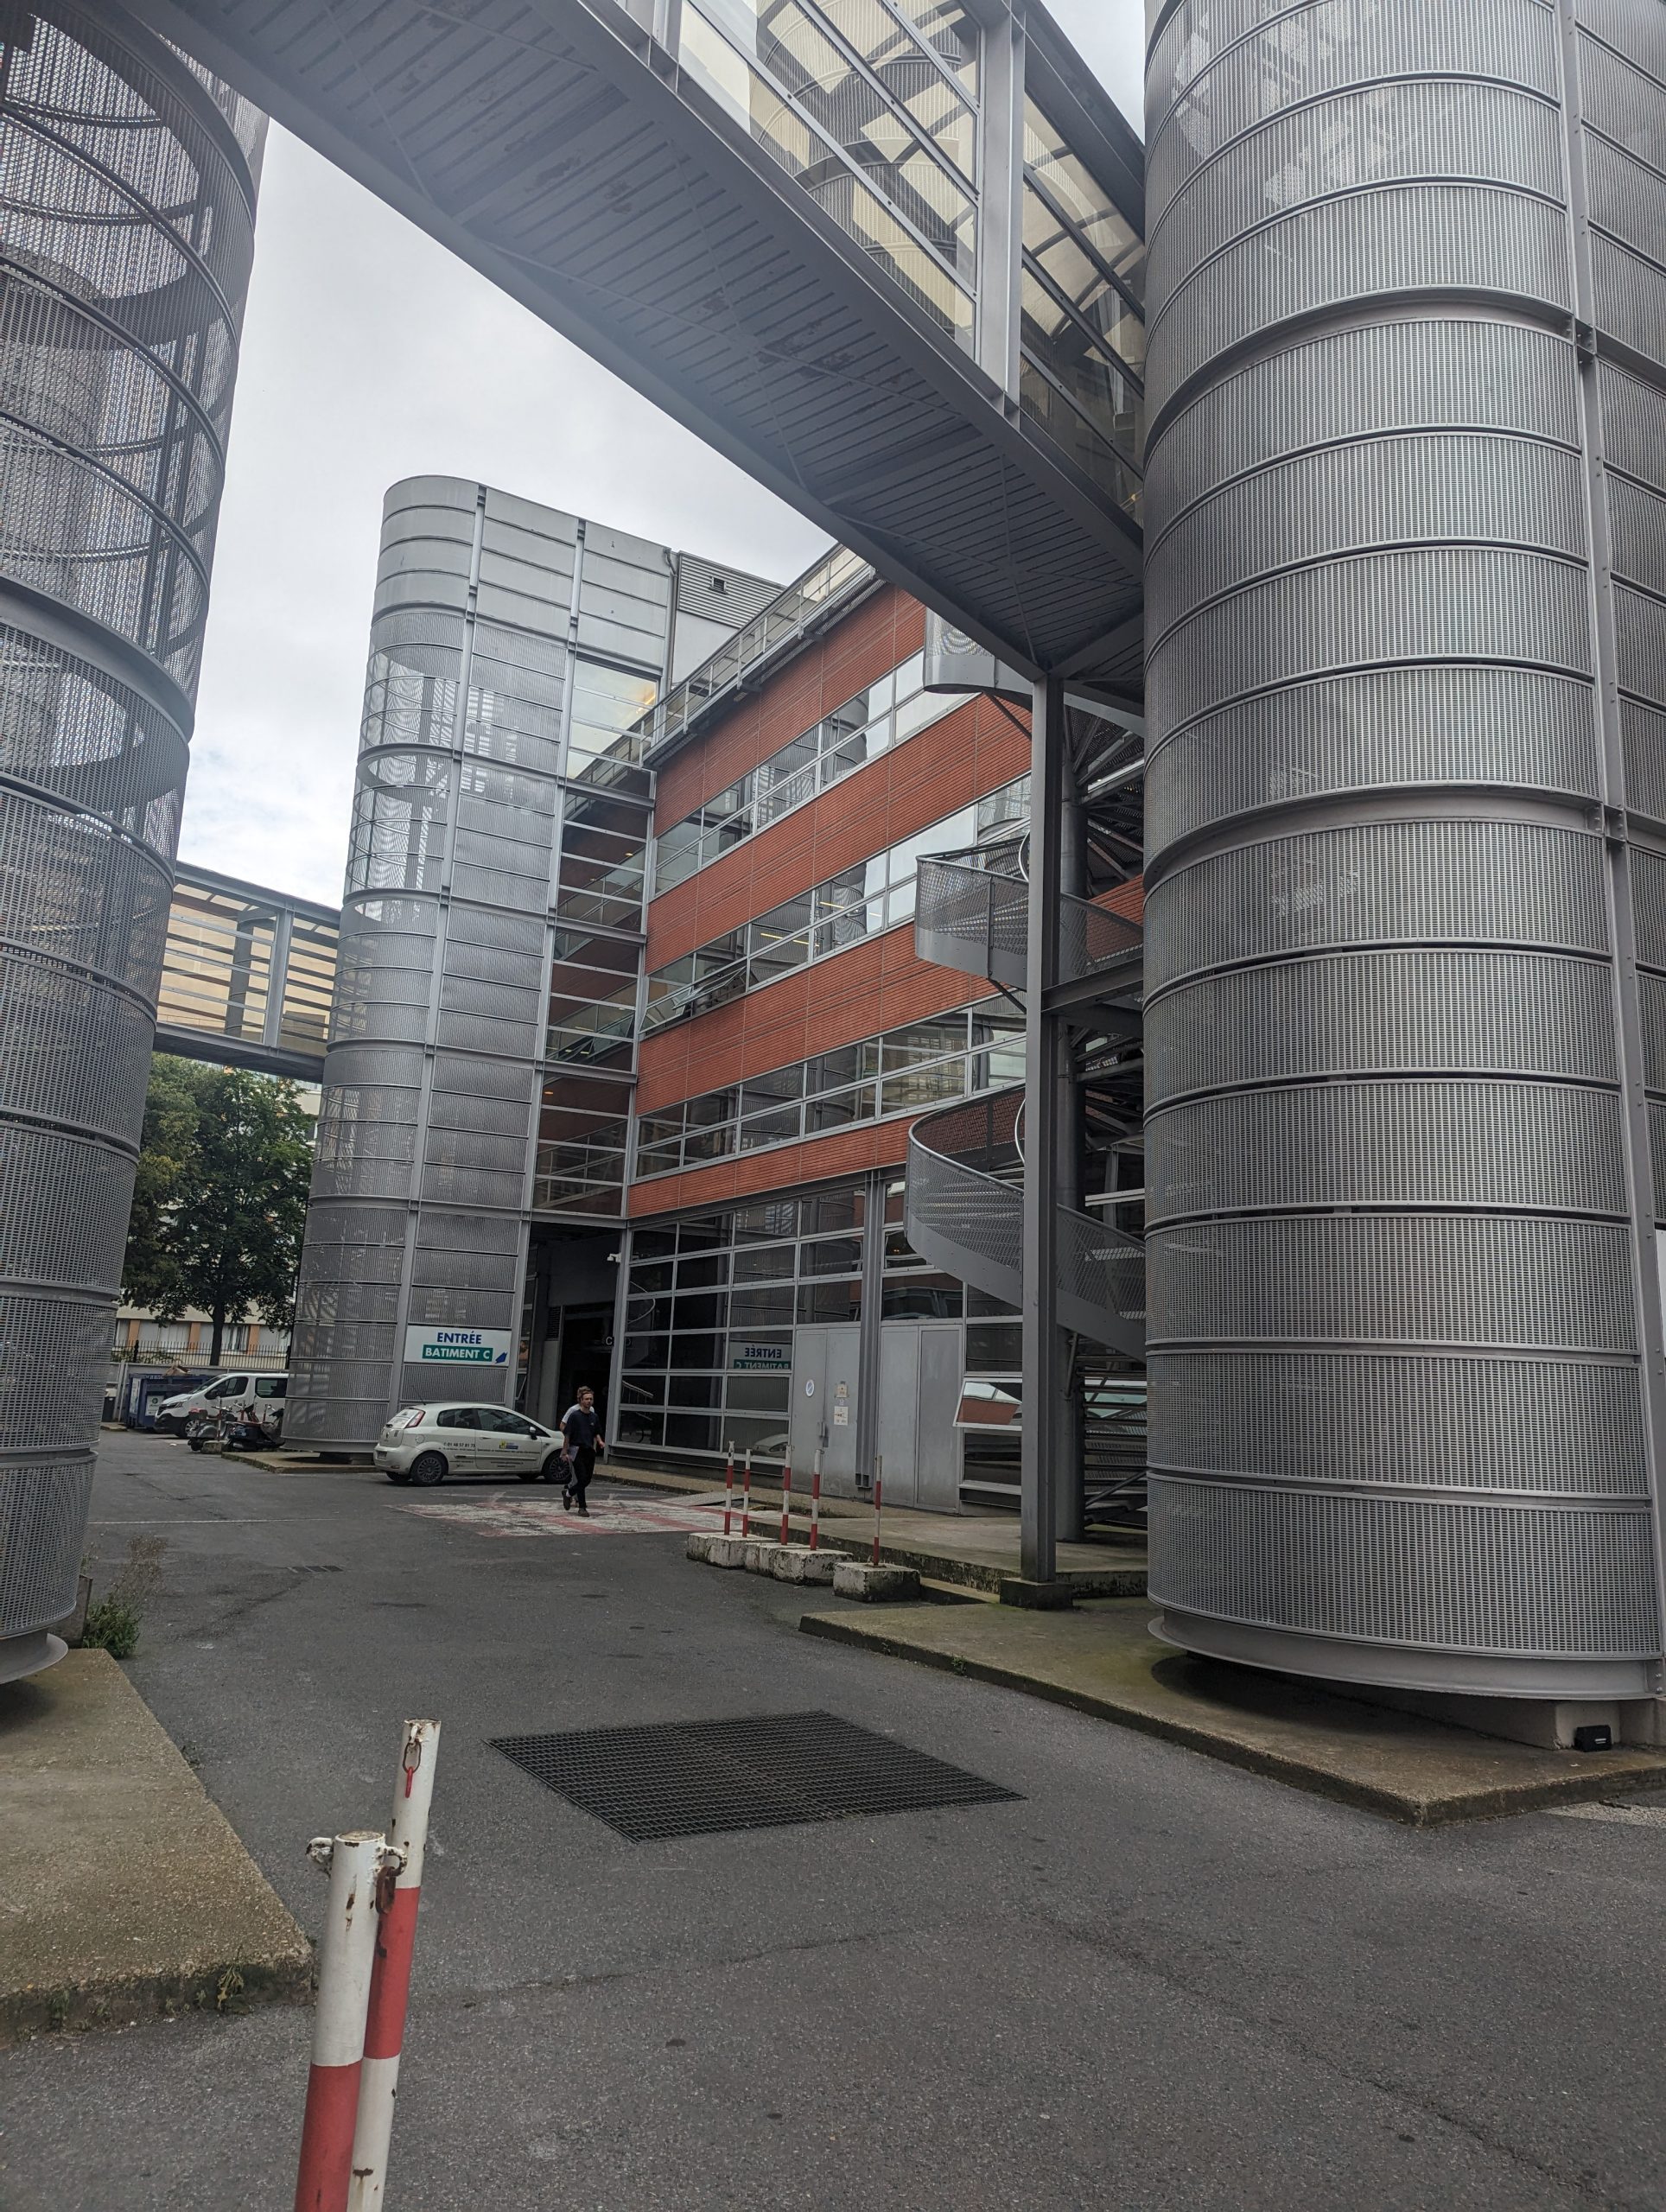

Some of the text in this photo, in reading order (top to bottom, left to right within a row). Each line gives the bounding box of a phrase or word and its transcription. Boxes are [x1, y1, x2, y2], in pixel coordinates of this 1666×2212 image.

[437, 1331, 481, 1344] ENTRÉE
[606, 1336, 612, 1344] C
[425, 1348, 490, 1359] BATIMENT C
